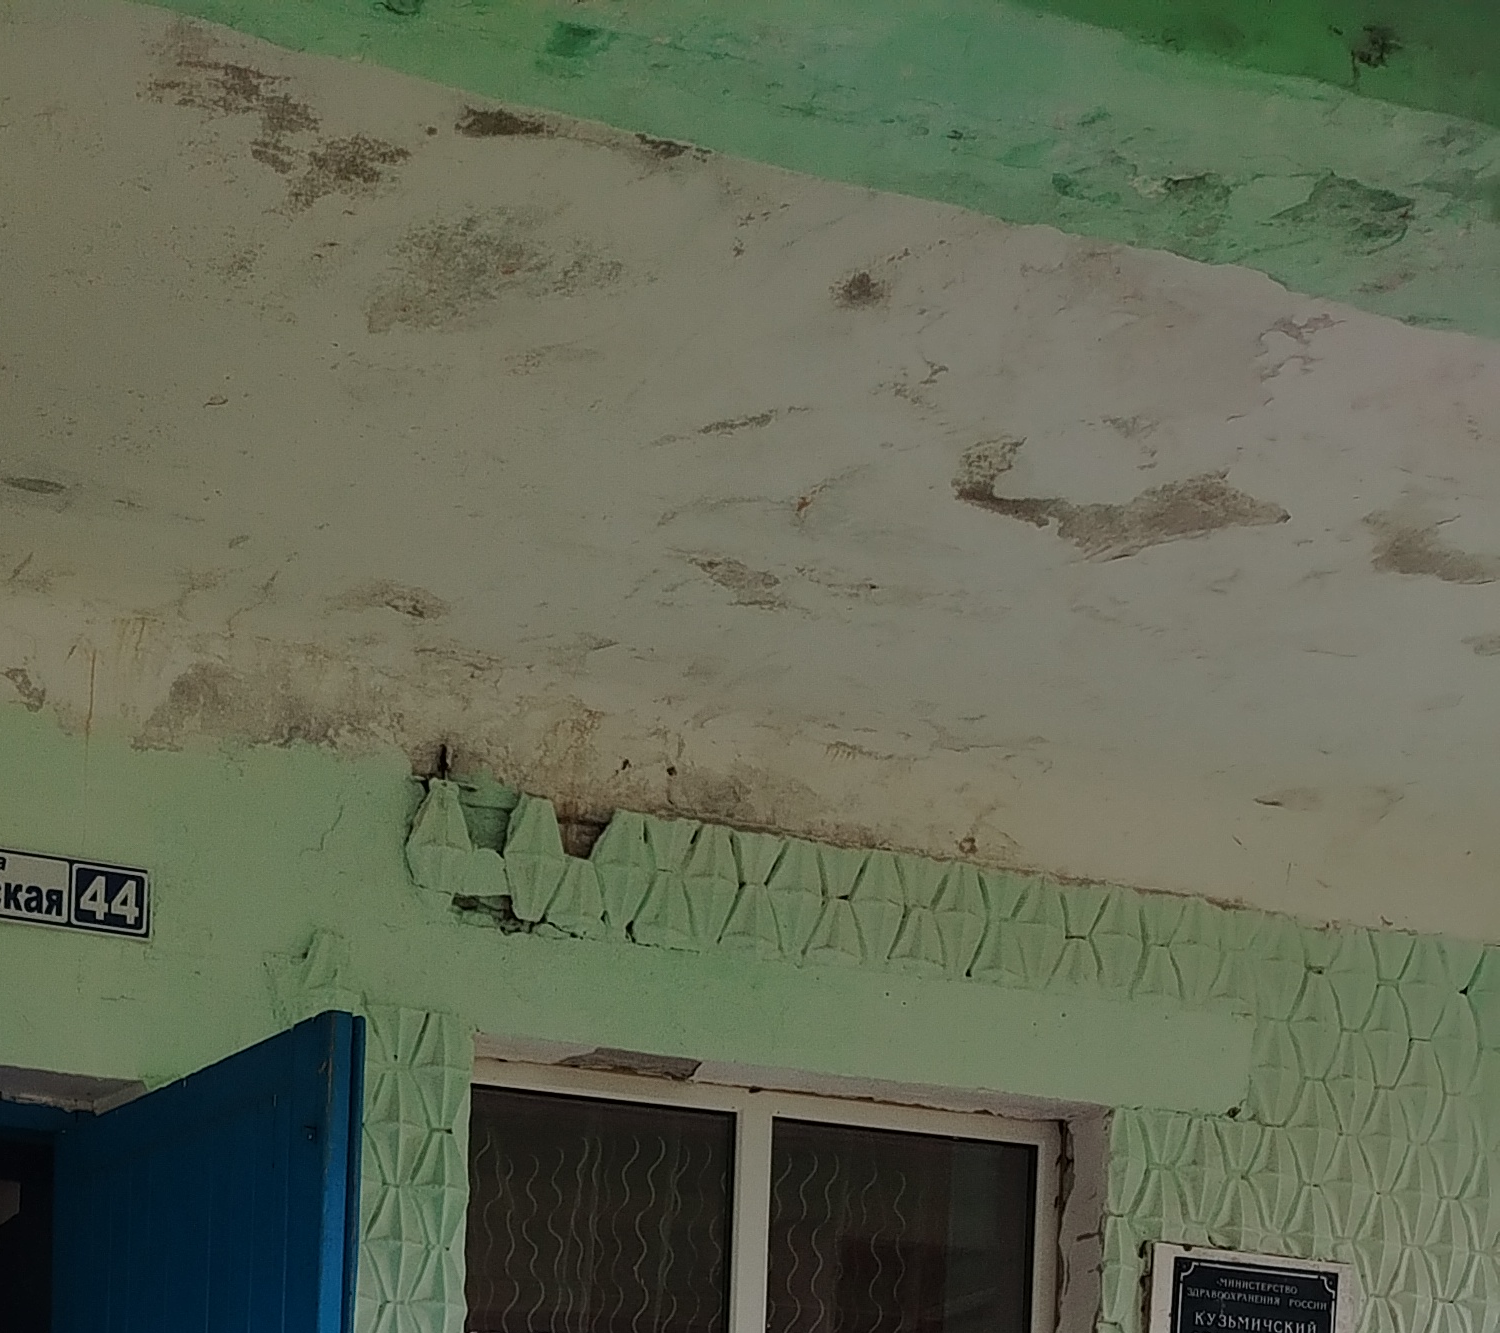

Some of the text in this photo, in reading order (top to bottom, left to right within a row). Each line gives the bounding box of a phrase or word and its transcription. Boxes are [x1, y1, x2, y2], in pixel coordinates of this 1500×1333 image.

[79, 875, 140, 925] 44
[1218, 1278, 1298, 1295] МИНИСТЕРСТВО
[1187, 1287, 1328, 1311] ЗДРАВООХРАНЕНИЯ РОССИИ
